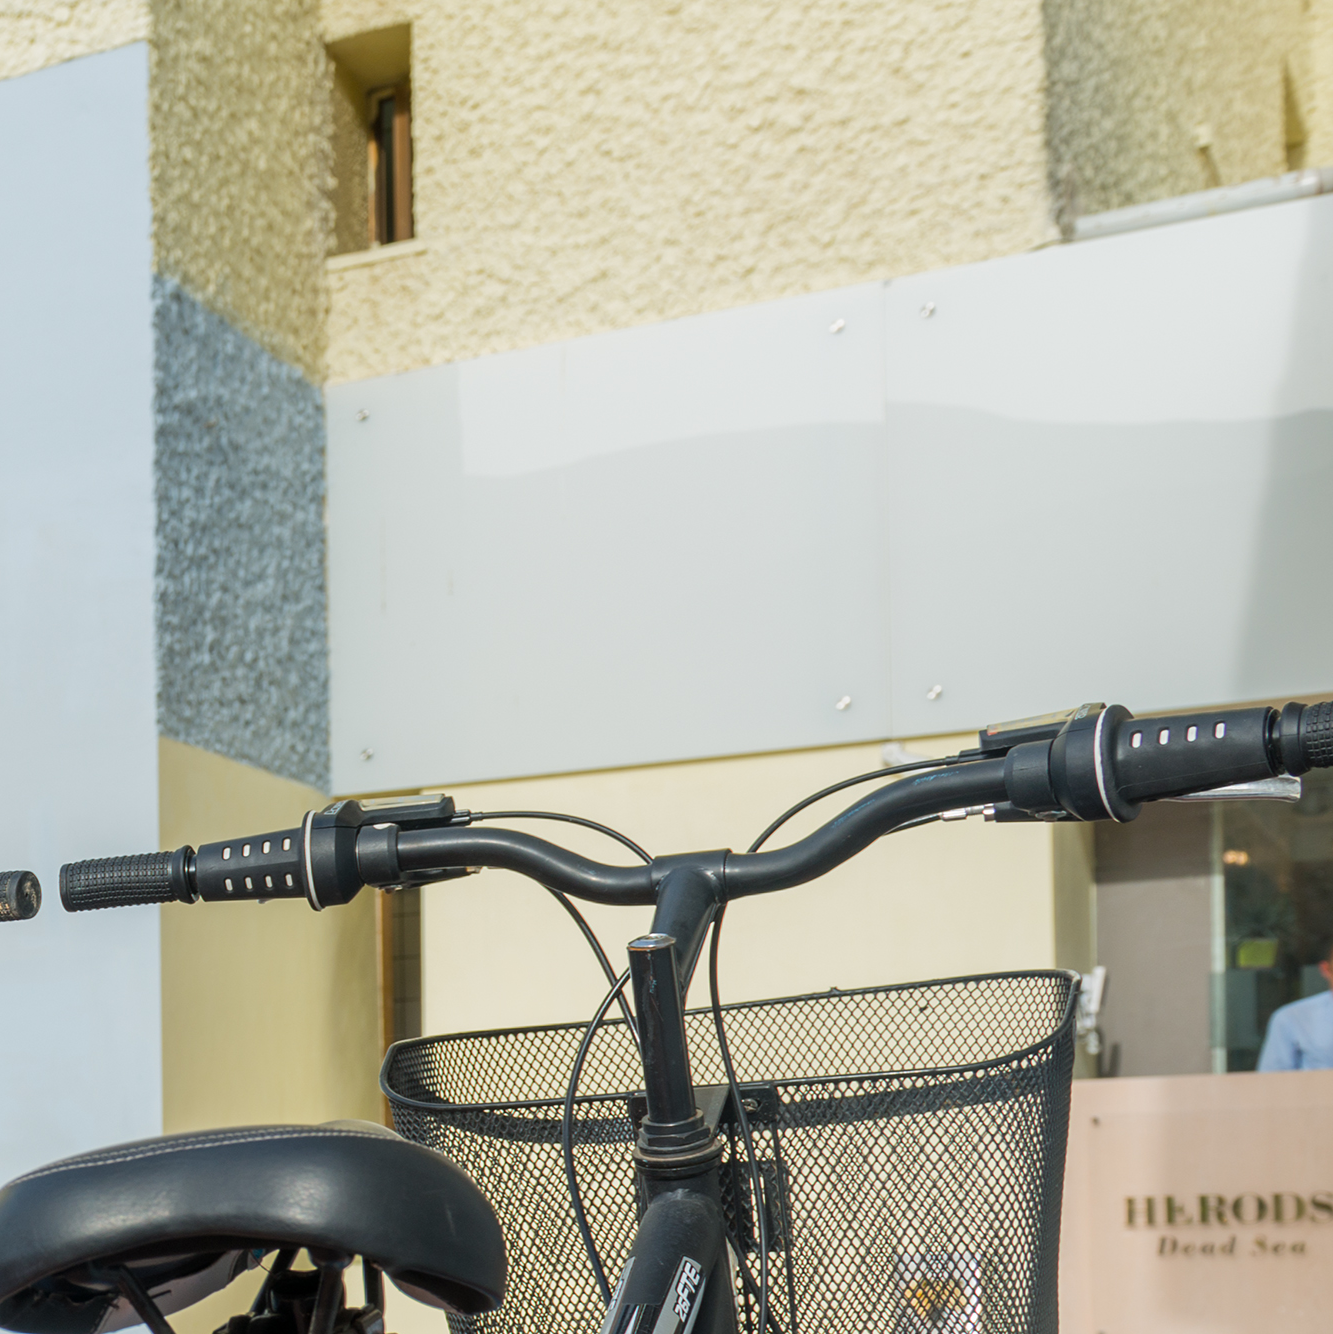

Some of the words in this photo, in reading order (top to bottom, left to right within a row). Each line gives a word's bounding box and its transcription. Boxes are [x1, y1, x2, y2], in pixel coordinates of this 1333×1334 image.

[1125, 1191, 1333, 1227] HERODS
[1158, 1235, 1237, 1256] Dead
[1250, 1234, 1306, 1256] Sea
[674, 1261, 700, 1323] 26FTE
